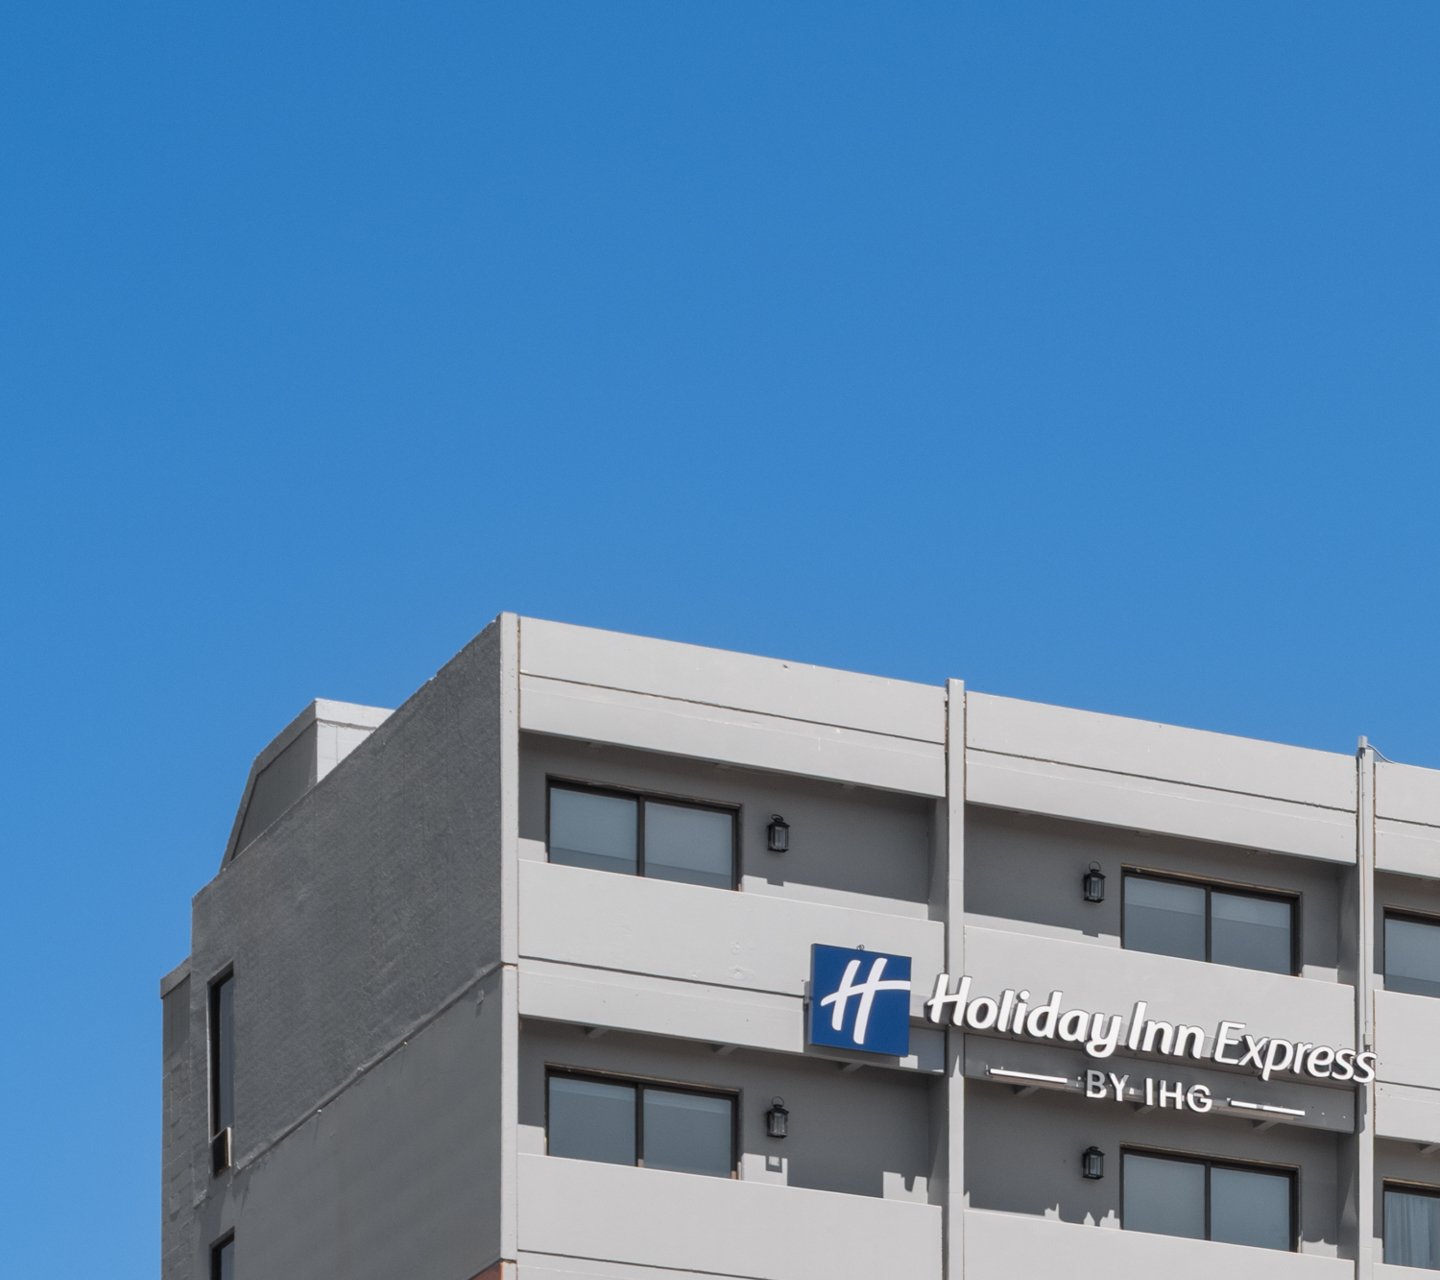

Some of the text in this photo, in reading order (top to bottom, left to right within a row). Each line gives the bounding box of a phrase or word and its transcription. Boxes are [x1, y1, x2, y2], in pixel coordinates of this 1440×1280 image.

[926, 973, 1378, 1084] Holiday Inn Express
[1085, 1069, 1214, 1113] BY IHG
